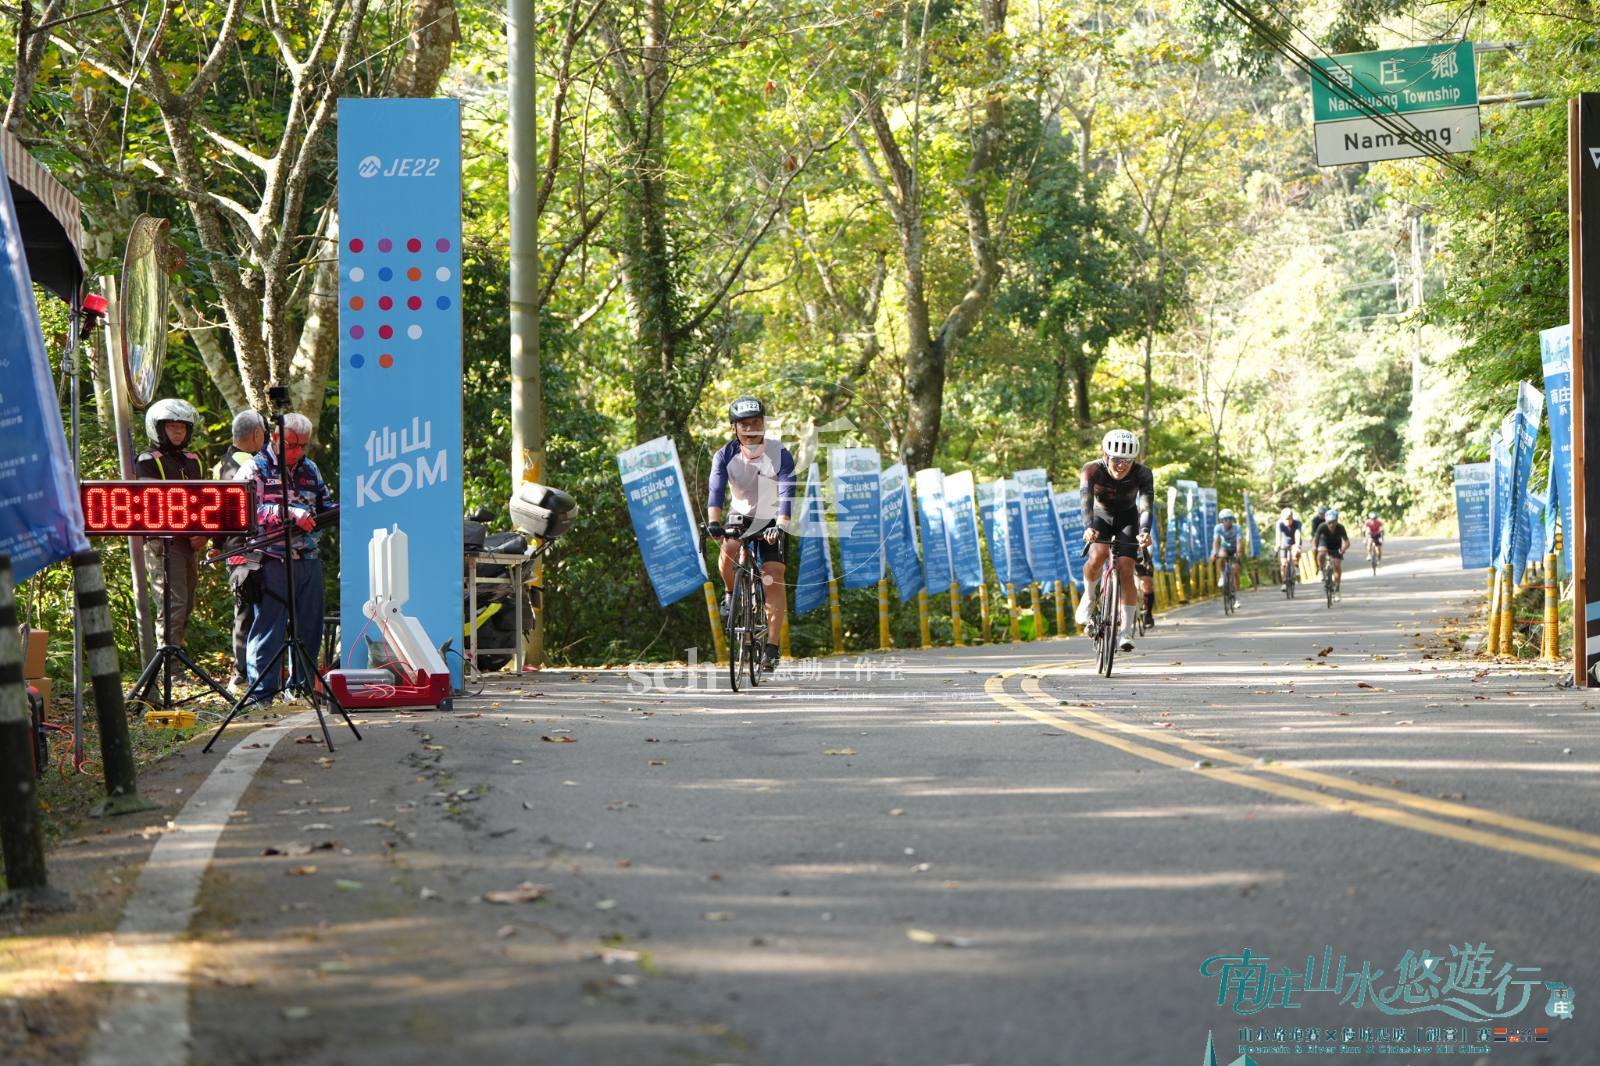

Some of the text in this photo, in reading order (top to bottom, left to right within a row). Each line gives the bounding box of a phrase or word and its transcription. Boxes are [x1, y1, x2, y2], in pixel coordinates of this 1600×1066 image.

[1403, 85, 1461, 104] Township
[1344, 126, 1452, 150] Namzong
[383, 158, 441, 177] JE22
[364, 416, 432, 467] 仙山
[356, 449, 448, 508] KOM
[86, 487, 248, 529] 08:08:27
